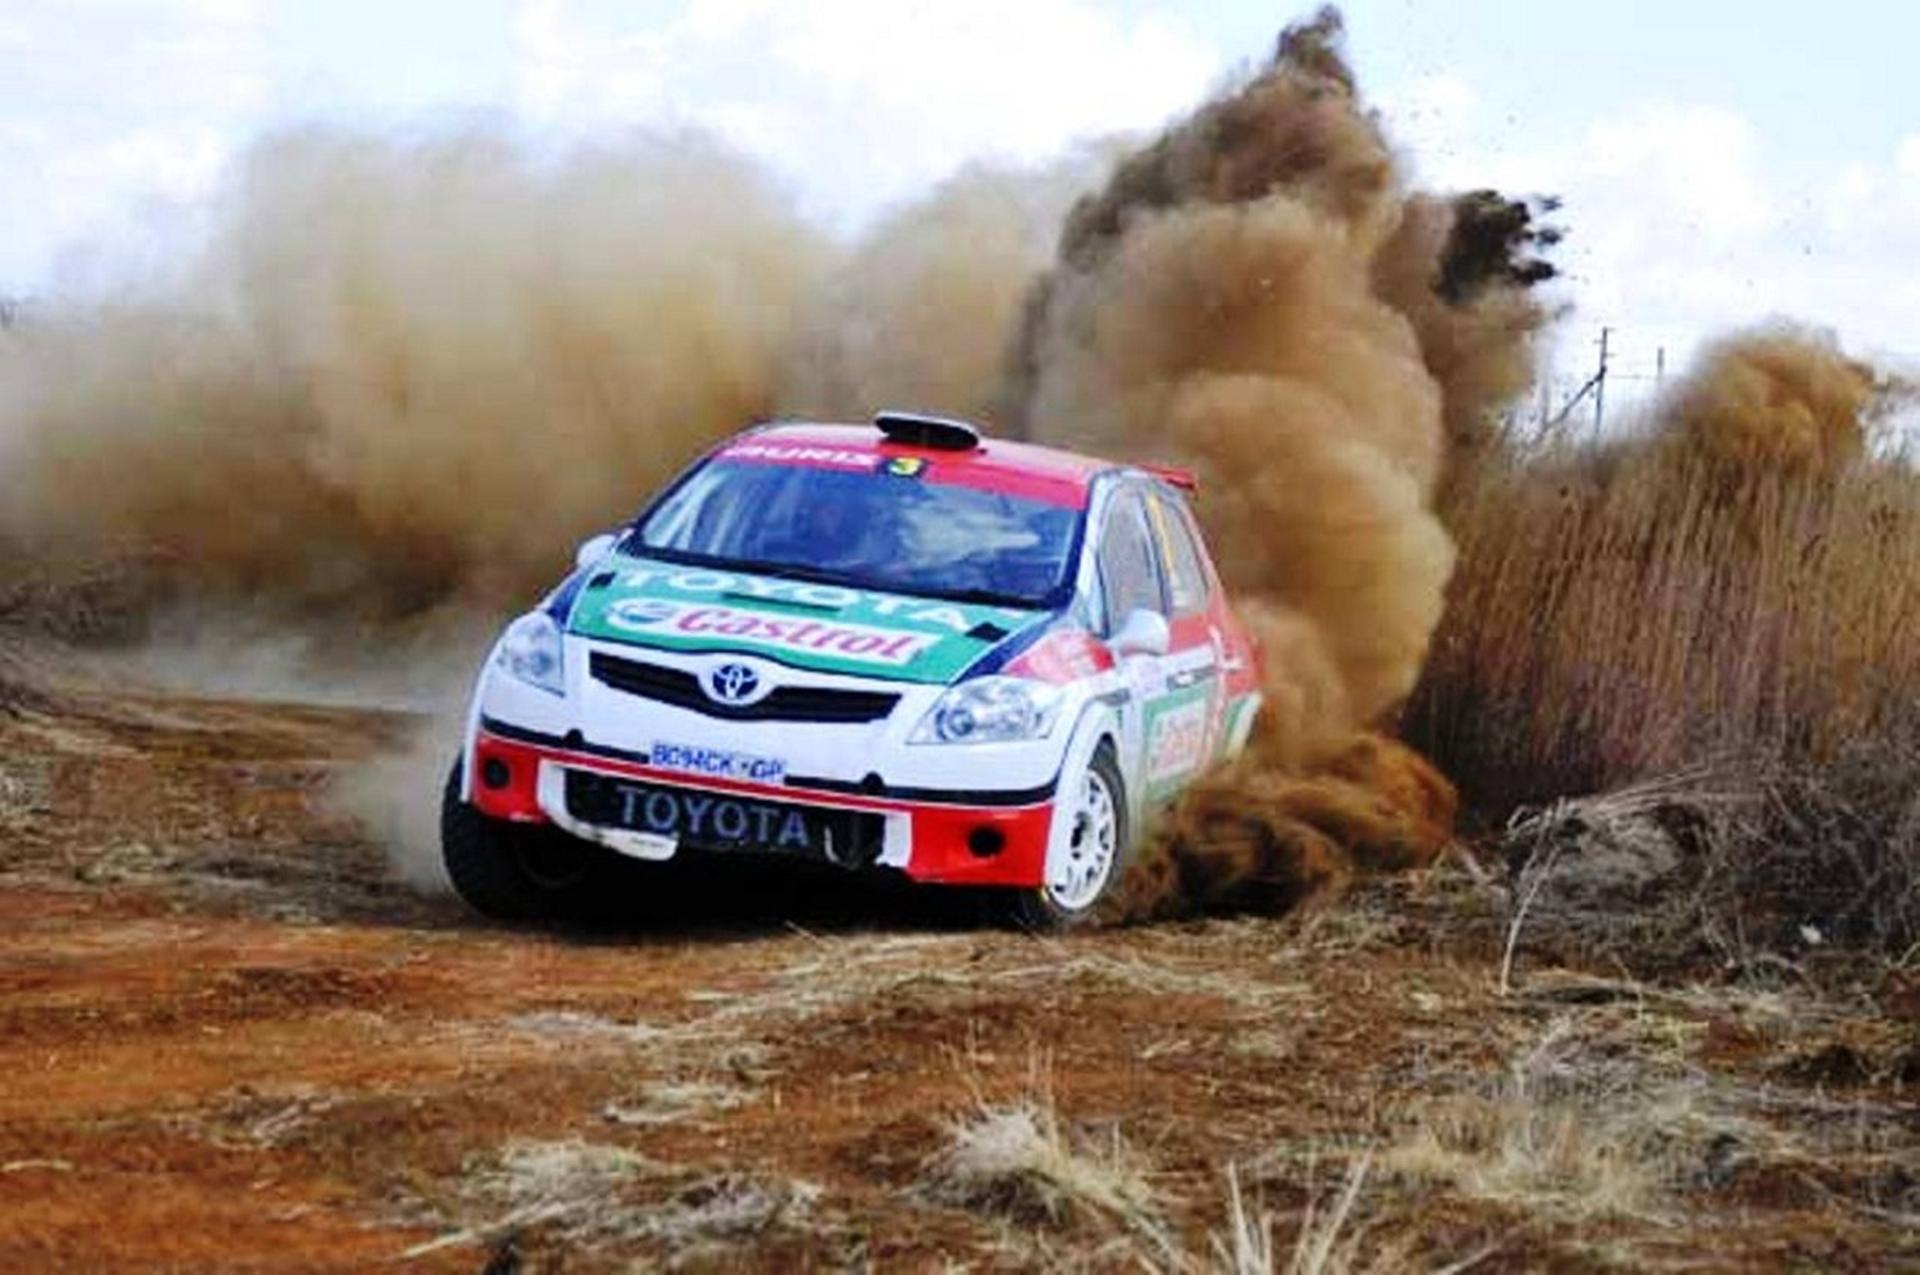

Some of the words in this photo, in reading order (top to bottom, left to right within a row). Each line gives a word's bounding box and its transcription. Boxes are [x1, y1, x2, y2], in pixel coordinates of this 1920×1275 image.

[621, 569, 971, 632] TOYOTA
[676, 608, 912, 656] Castrol
[617, 785, 809, 846] TOYOTA
